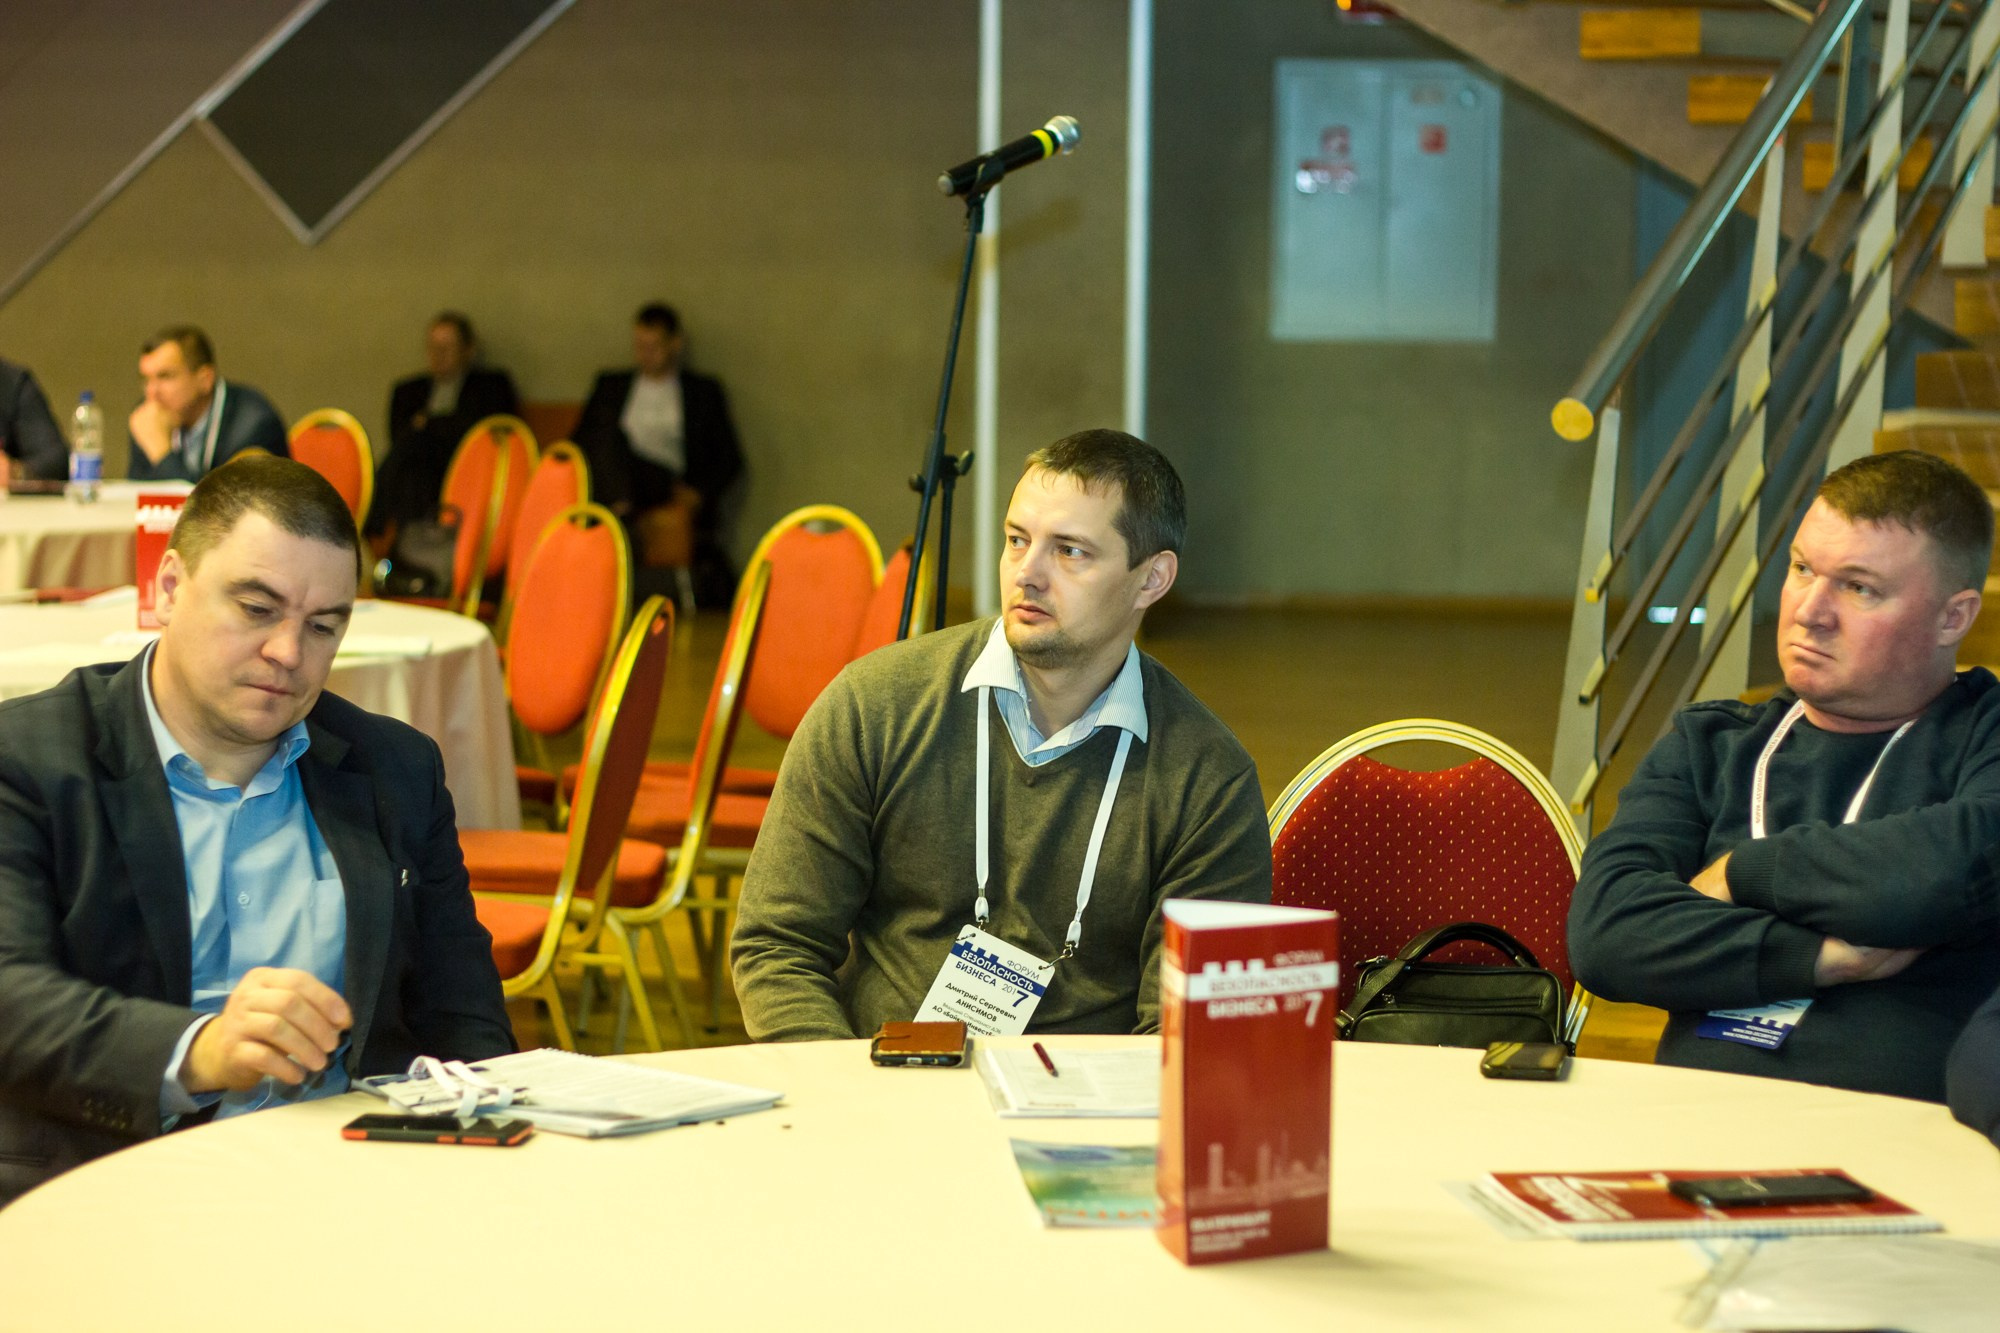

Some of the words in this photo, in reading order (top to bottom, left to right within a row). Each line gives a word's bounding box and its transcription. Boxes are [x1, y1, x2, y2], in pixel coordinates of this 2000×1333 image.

[955, 961, 997, 987] БИЗНЕСА
[1002, 984, 1029, 1008] 2017
[961, 950, 1034, 991] БЕЗОПАСНОСТЬ
[1006, 959, 1040, 981] ФОРУМ
[932, 1005, 943, 1013] АО
[945, 982, 978, 1002] Дмитрий
[978, 998, 1017, 1021] Сергеевич
[955, 999, 997, 1022] АНИСИМОВ
